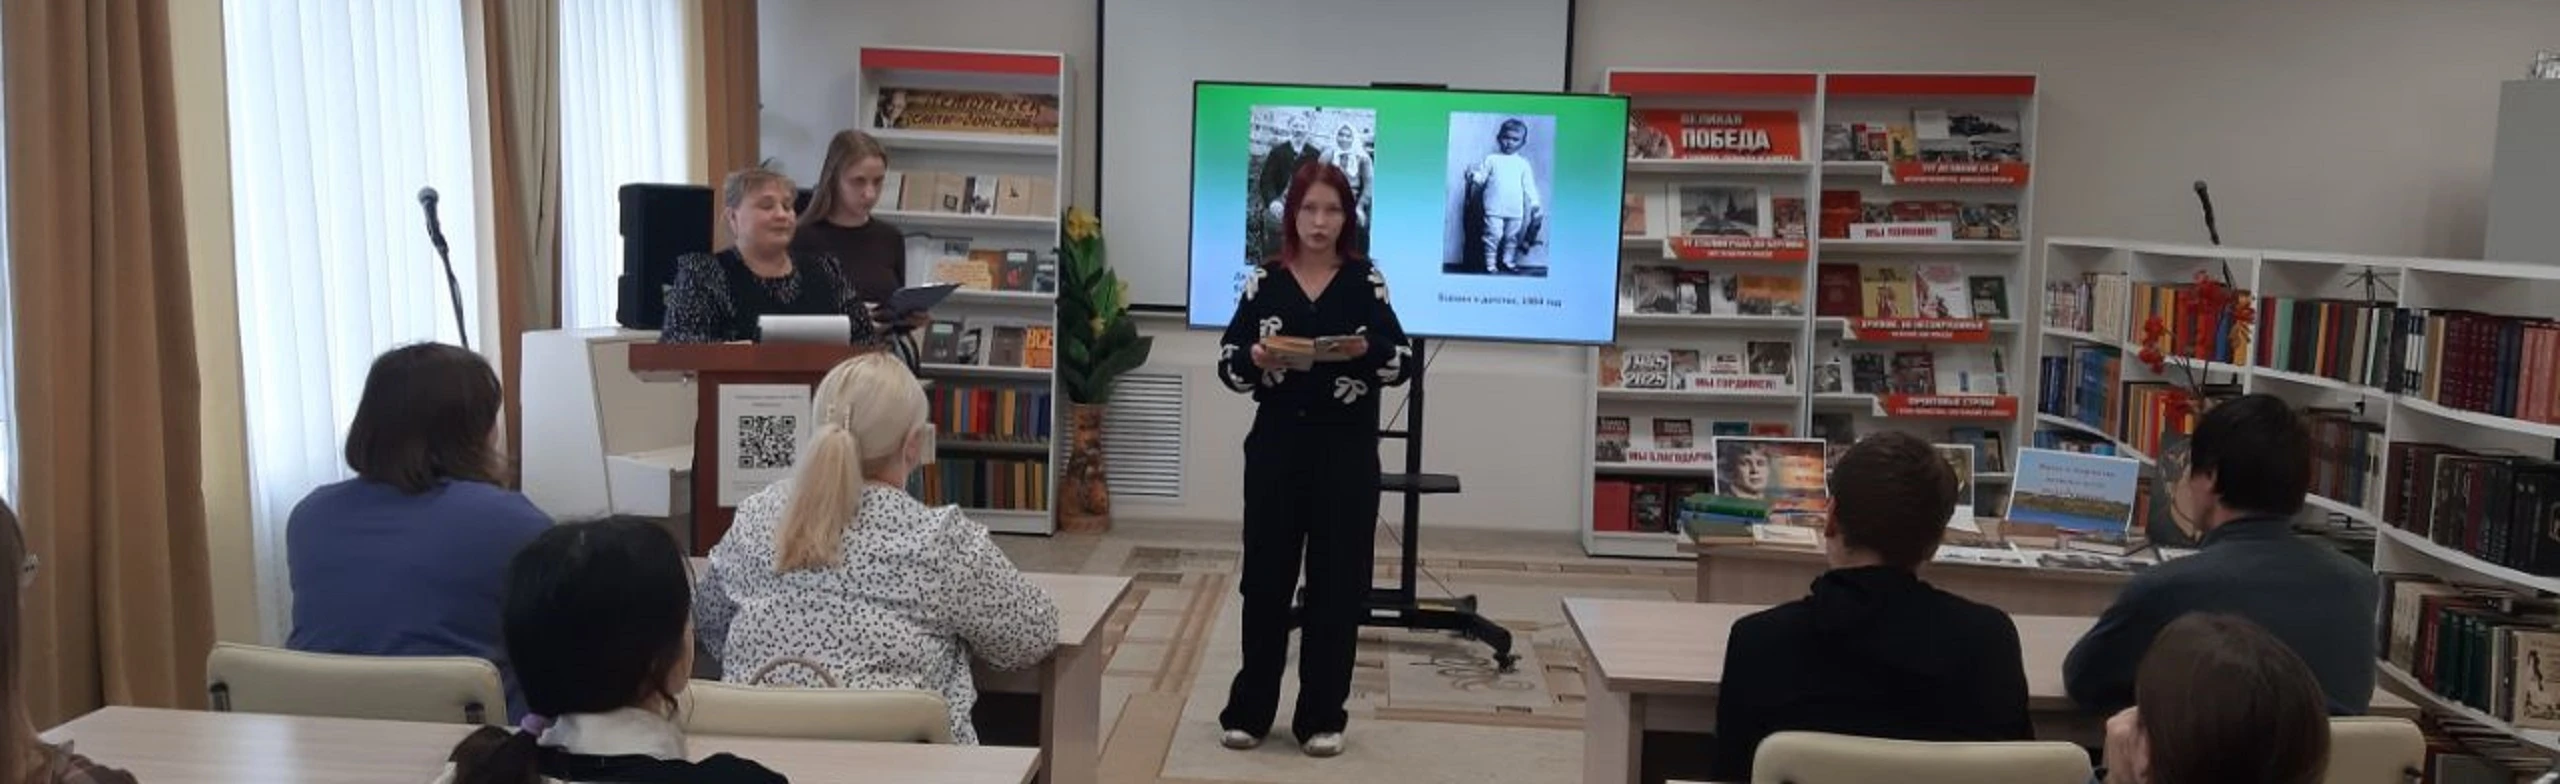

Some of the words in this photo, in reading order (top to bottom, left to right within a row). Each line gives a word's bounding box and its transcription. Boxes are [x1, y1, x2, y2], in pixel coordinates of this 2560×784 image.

[1681, 128, 1772, 151] ПОБЕДА
[1625, 371, 1667, 388] 2025
[1695, 377, 1714, 389] МЫ
[1628, 451, 1648, 461] МЫ
